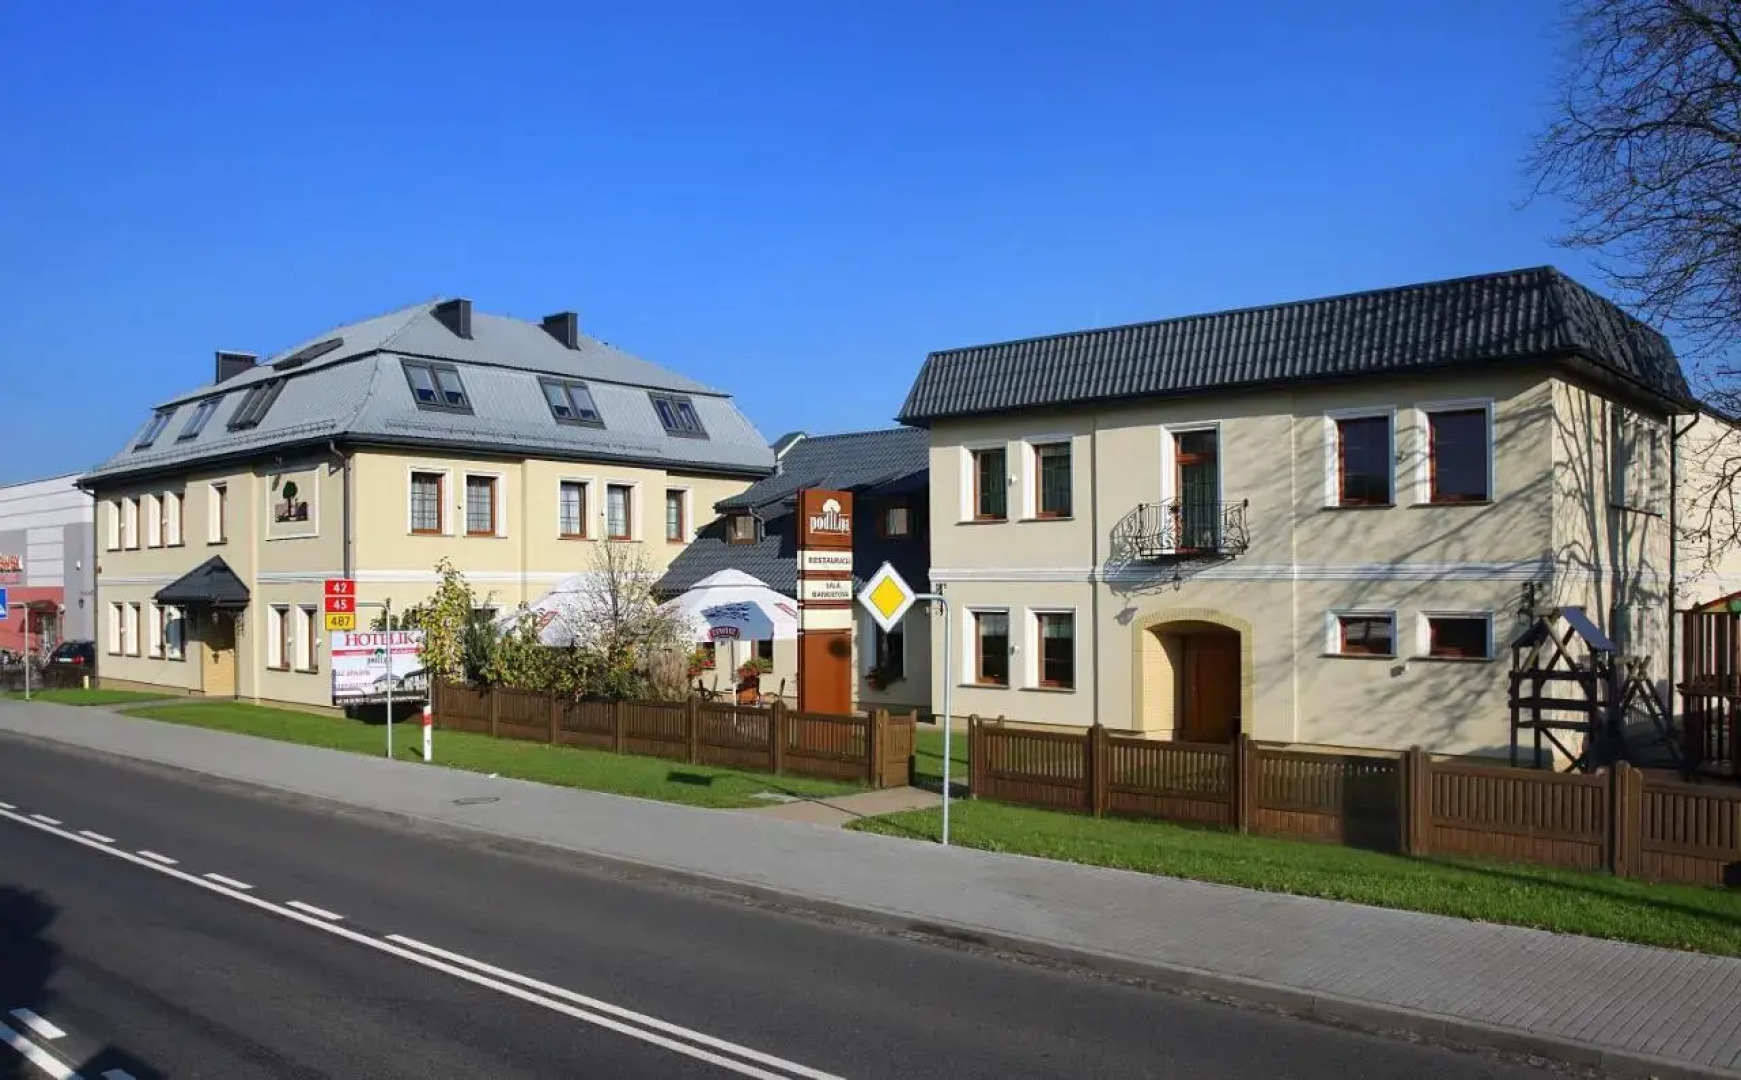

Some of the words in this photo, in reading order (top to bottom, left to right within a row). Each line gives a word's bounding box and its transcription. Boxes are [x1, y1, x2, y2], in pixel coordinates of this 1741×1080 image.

[333, 582, 347, 593] 42
[333, 599, 347, 610] 45
[331, 616, 350, 626] 487
[345, 632, 415, 646] HOTELIK
